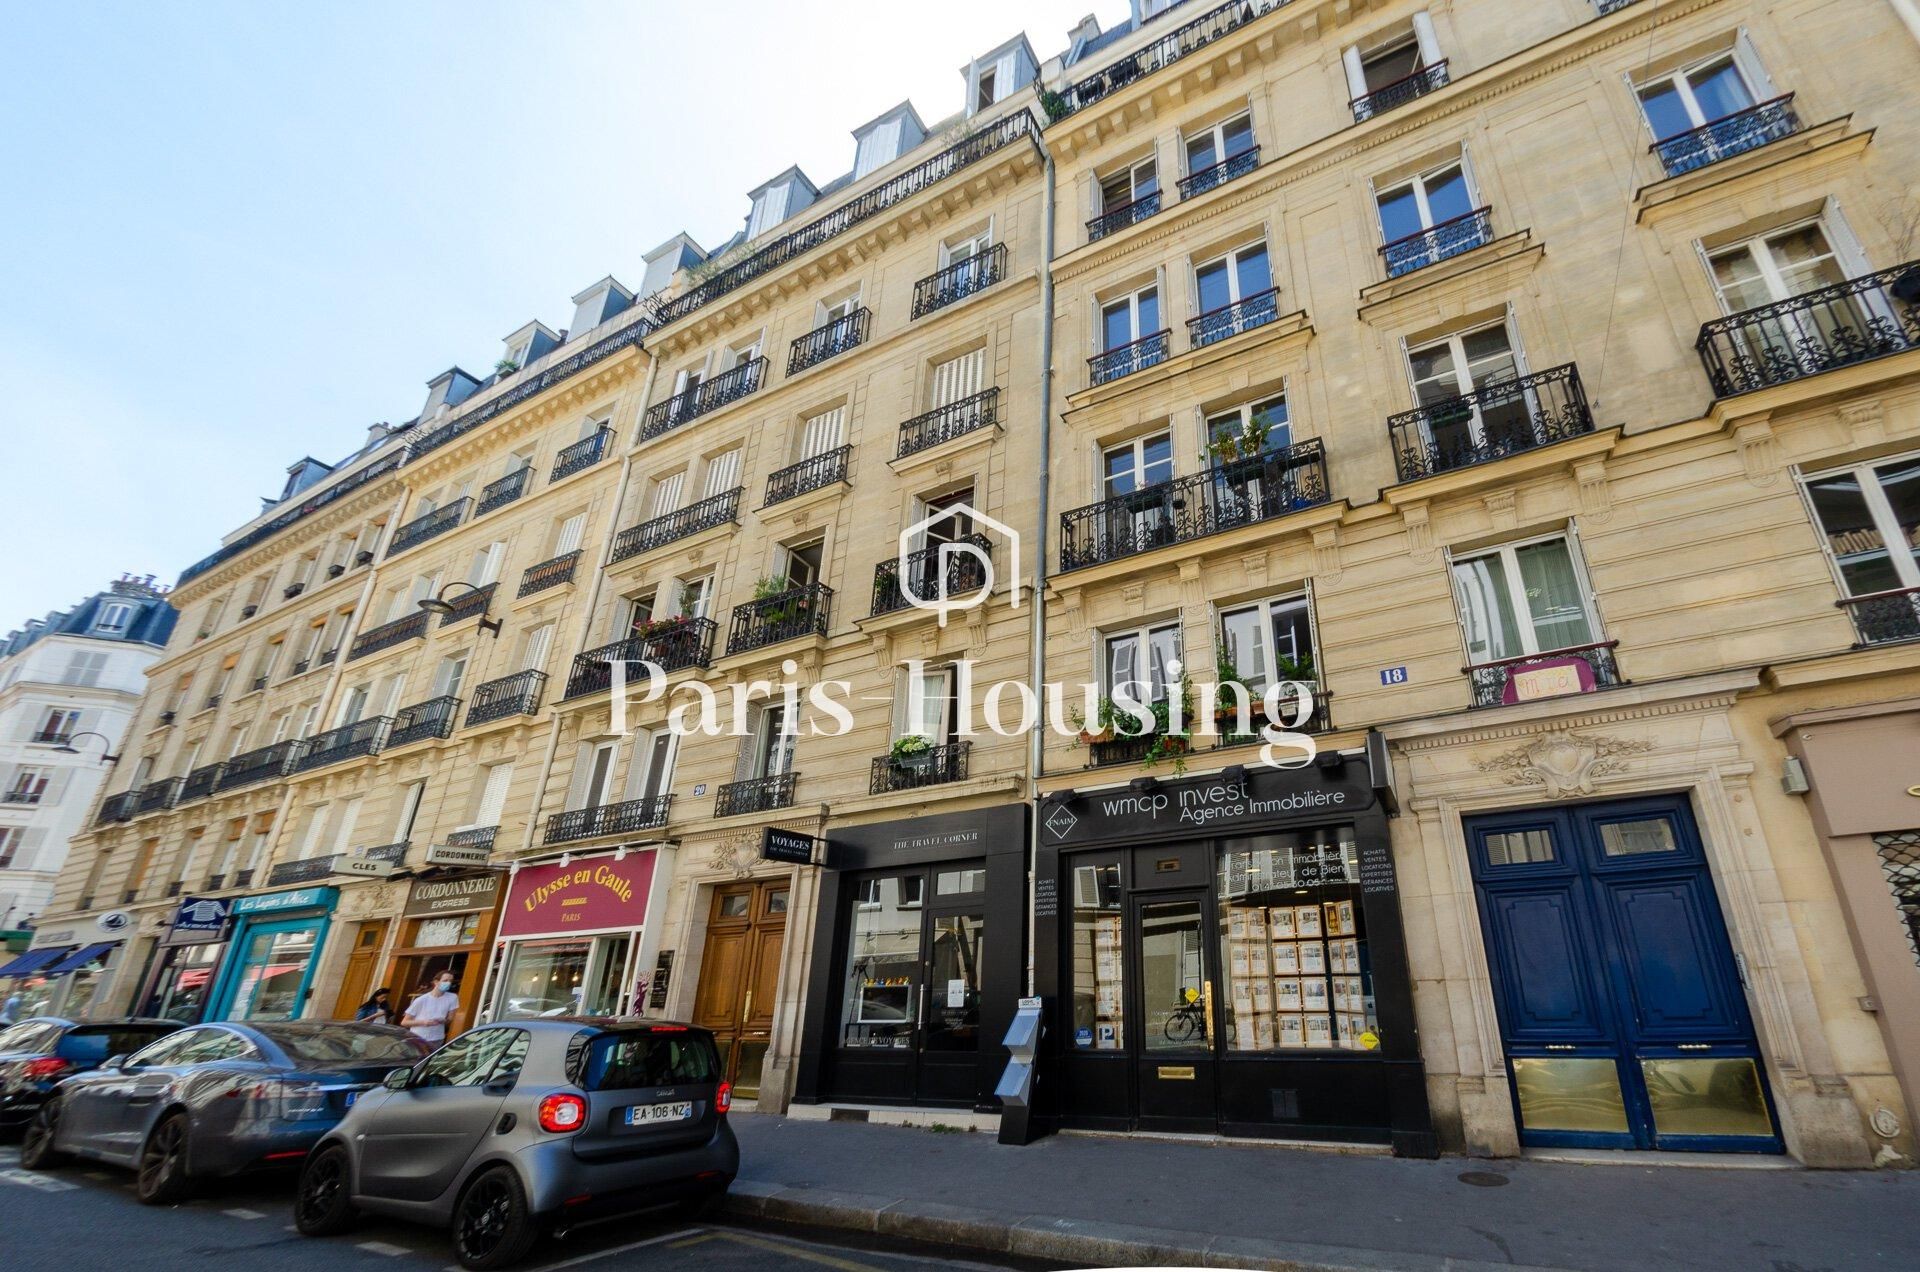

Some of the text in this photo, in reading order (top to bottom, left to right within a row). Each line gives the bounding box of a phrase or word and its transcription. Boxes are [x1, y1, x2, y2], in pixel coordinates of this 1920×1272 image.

[1384, 669, 1403, 683] 18
[695, 785, 705, 796] 20
[1103, 794, 1168, 819] wmcp
[1179, 790, 1345, 824] Agence Immobilière
[1048, 817, 1074, 827] FNAIM
[771, 835, 810, 851] VOYAGES
[894, 832, 978, 850] THE TRAVEL CORNER
[435, 850, 487, 861] CORDONNERIE
[352, 862, 377, 871] CLES
[1301, 866, 1317, 877] de
[1361, 863, 1392, 871] LOCATIONS
[1360, 870, 1393, 878] EXPERTISES
[415, 877, 497, 900] CORDONNERIE
[524, 865, 632, 913] Ulysse en Gaule
[430, 897, 470, 909] EXPRESS
[561, 913, 581, 922] PARIS
